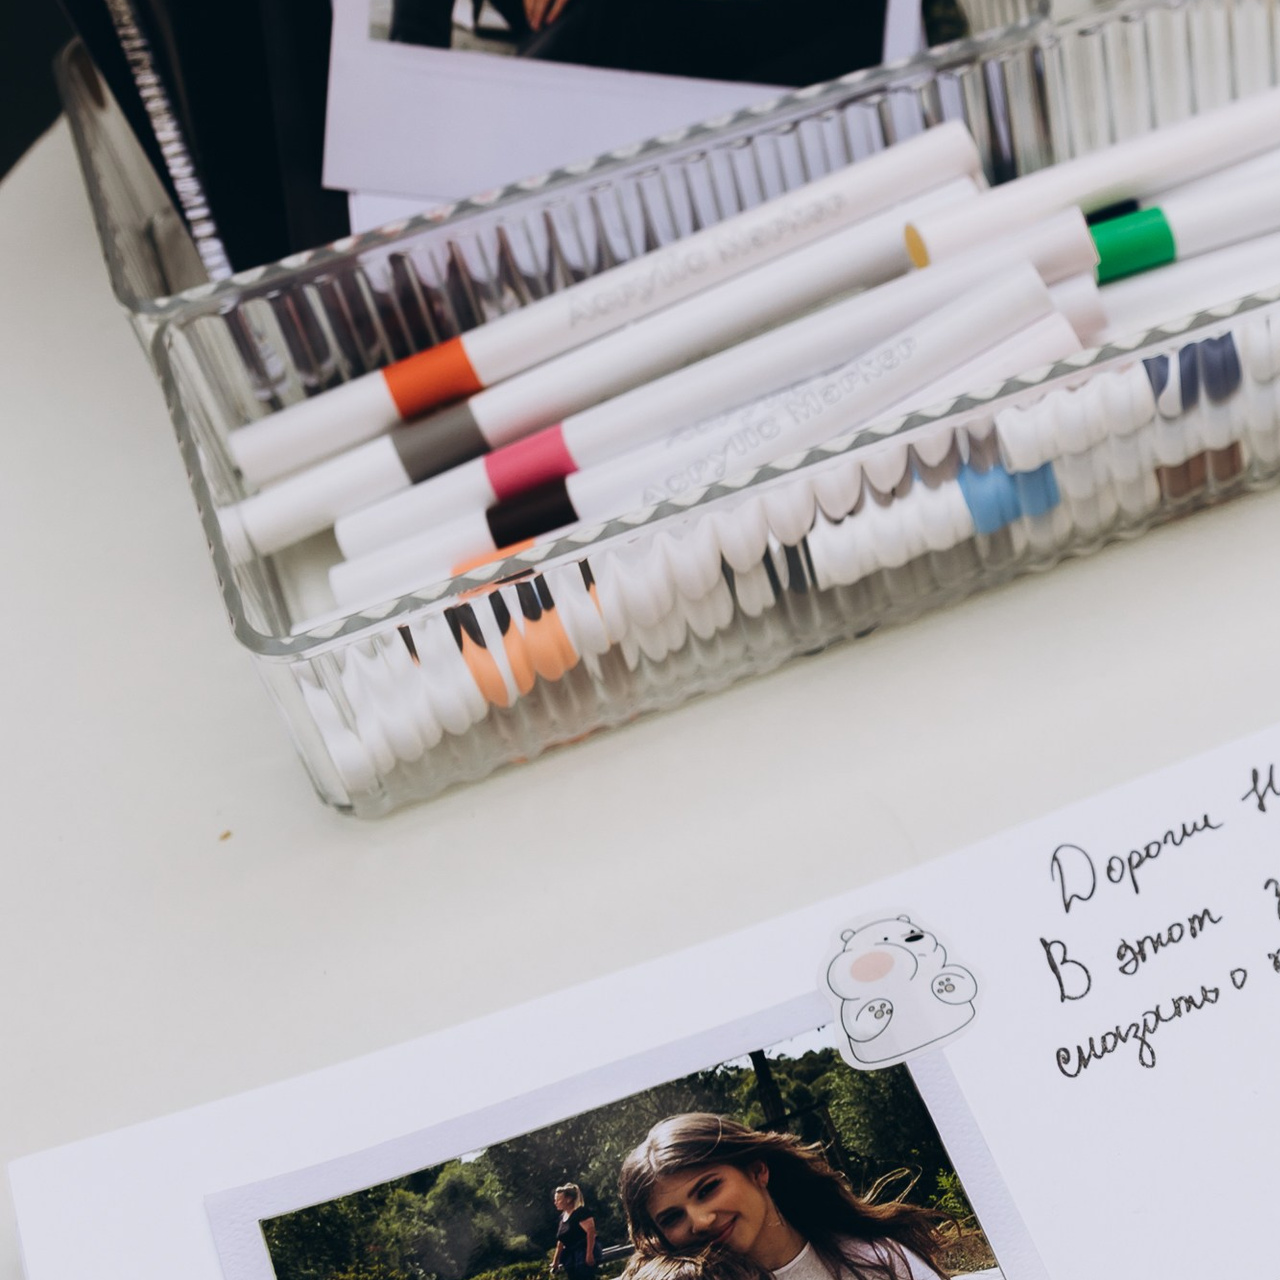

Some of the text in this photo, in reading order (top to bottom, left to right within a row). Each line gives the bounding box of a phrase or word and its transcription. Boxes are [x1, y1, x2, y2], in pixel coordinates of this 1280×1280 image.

[640, 414, 780, 508] Acrylic
[786, 335, 920, 424] Marker
[1040, 935, 1092, 1003] В
[1116, 906, 1223, 977] этот
[1055, 985, 1221, 1080] сказать
[1230, 968, 1250, 992] о
